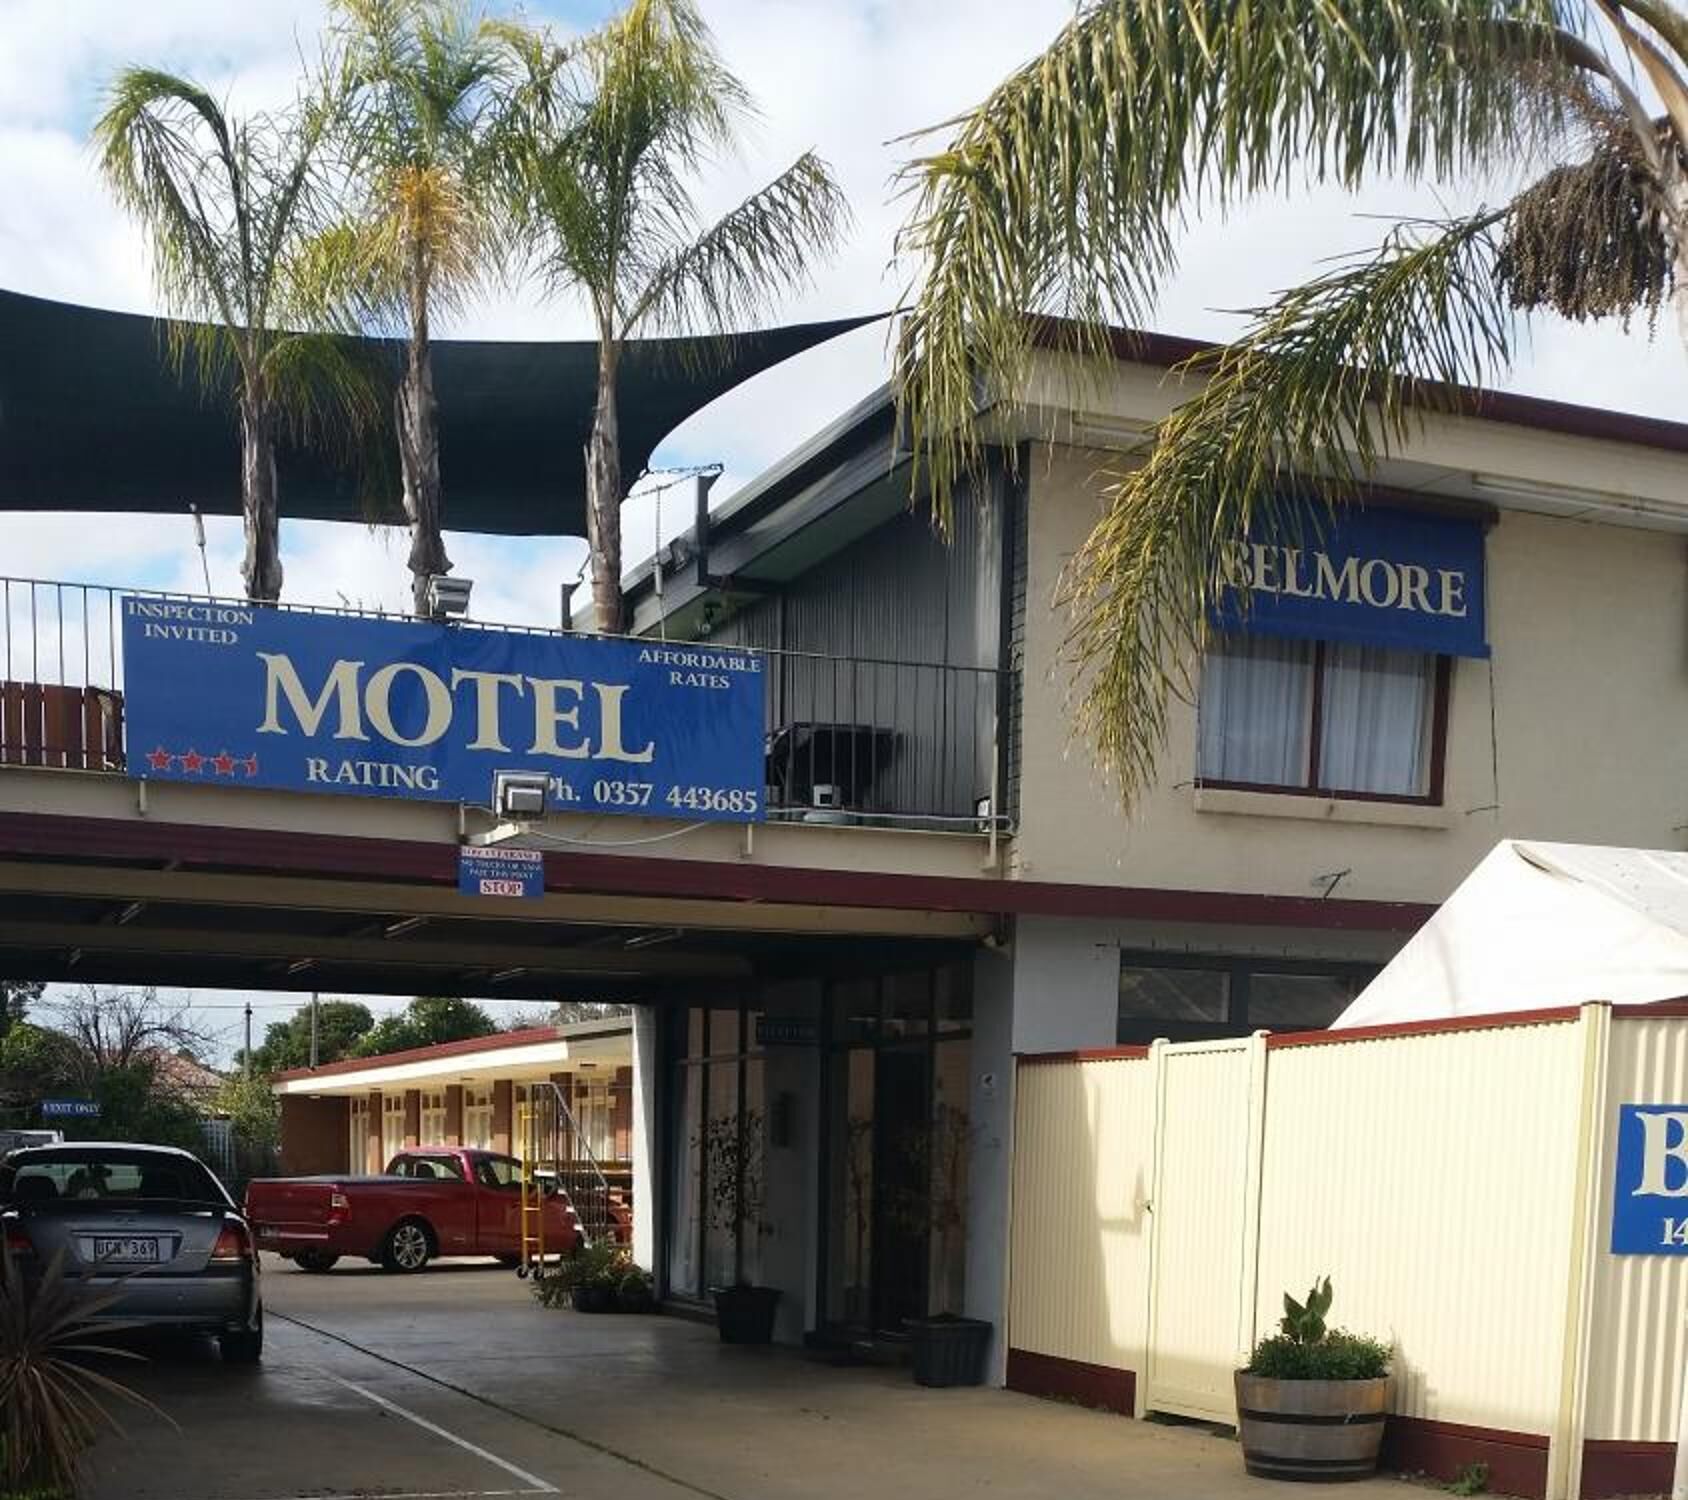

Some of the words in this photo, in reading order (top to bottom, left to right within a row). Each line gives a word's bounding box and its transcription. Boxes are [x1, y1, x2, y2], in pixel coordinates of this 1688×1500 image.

[1219, 539, 1468, 617] BELMORE
[128, 601, 254, 625] INSPECTION
[144, 623, 239, 645] INVITED
[639, 649, 761, 673] AFFORDABLE
[670, 671, 731, 689] RATES
[256, 651, 655, 763] MOTEL
[306, 757, 440, 791] RATING
[593, 780, 654, 805] 0357
[666, 785, 758, 813] 443685
[483, 881, 521, 895] STOP
[75, 1103, 100, 1113] ONLY
